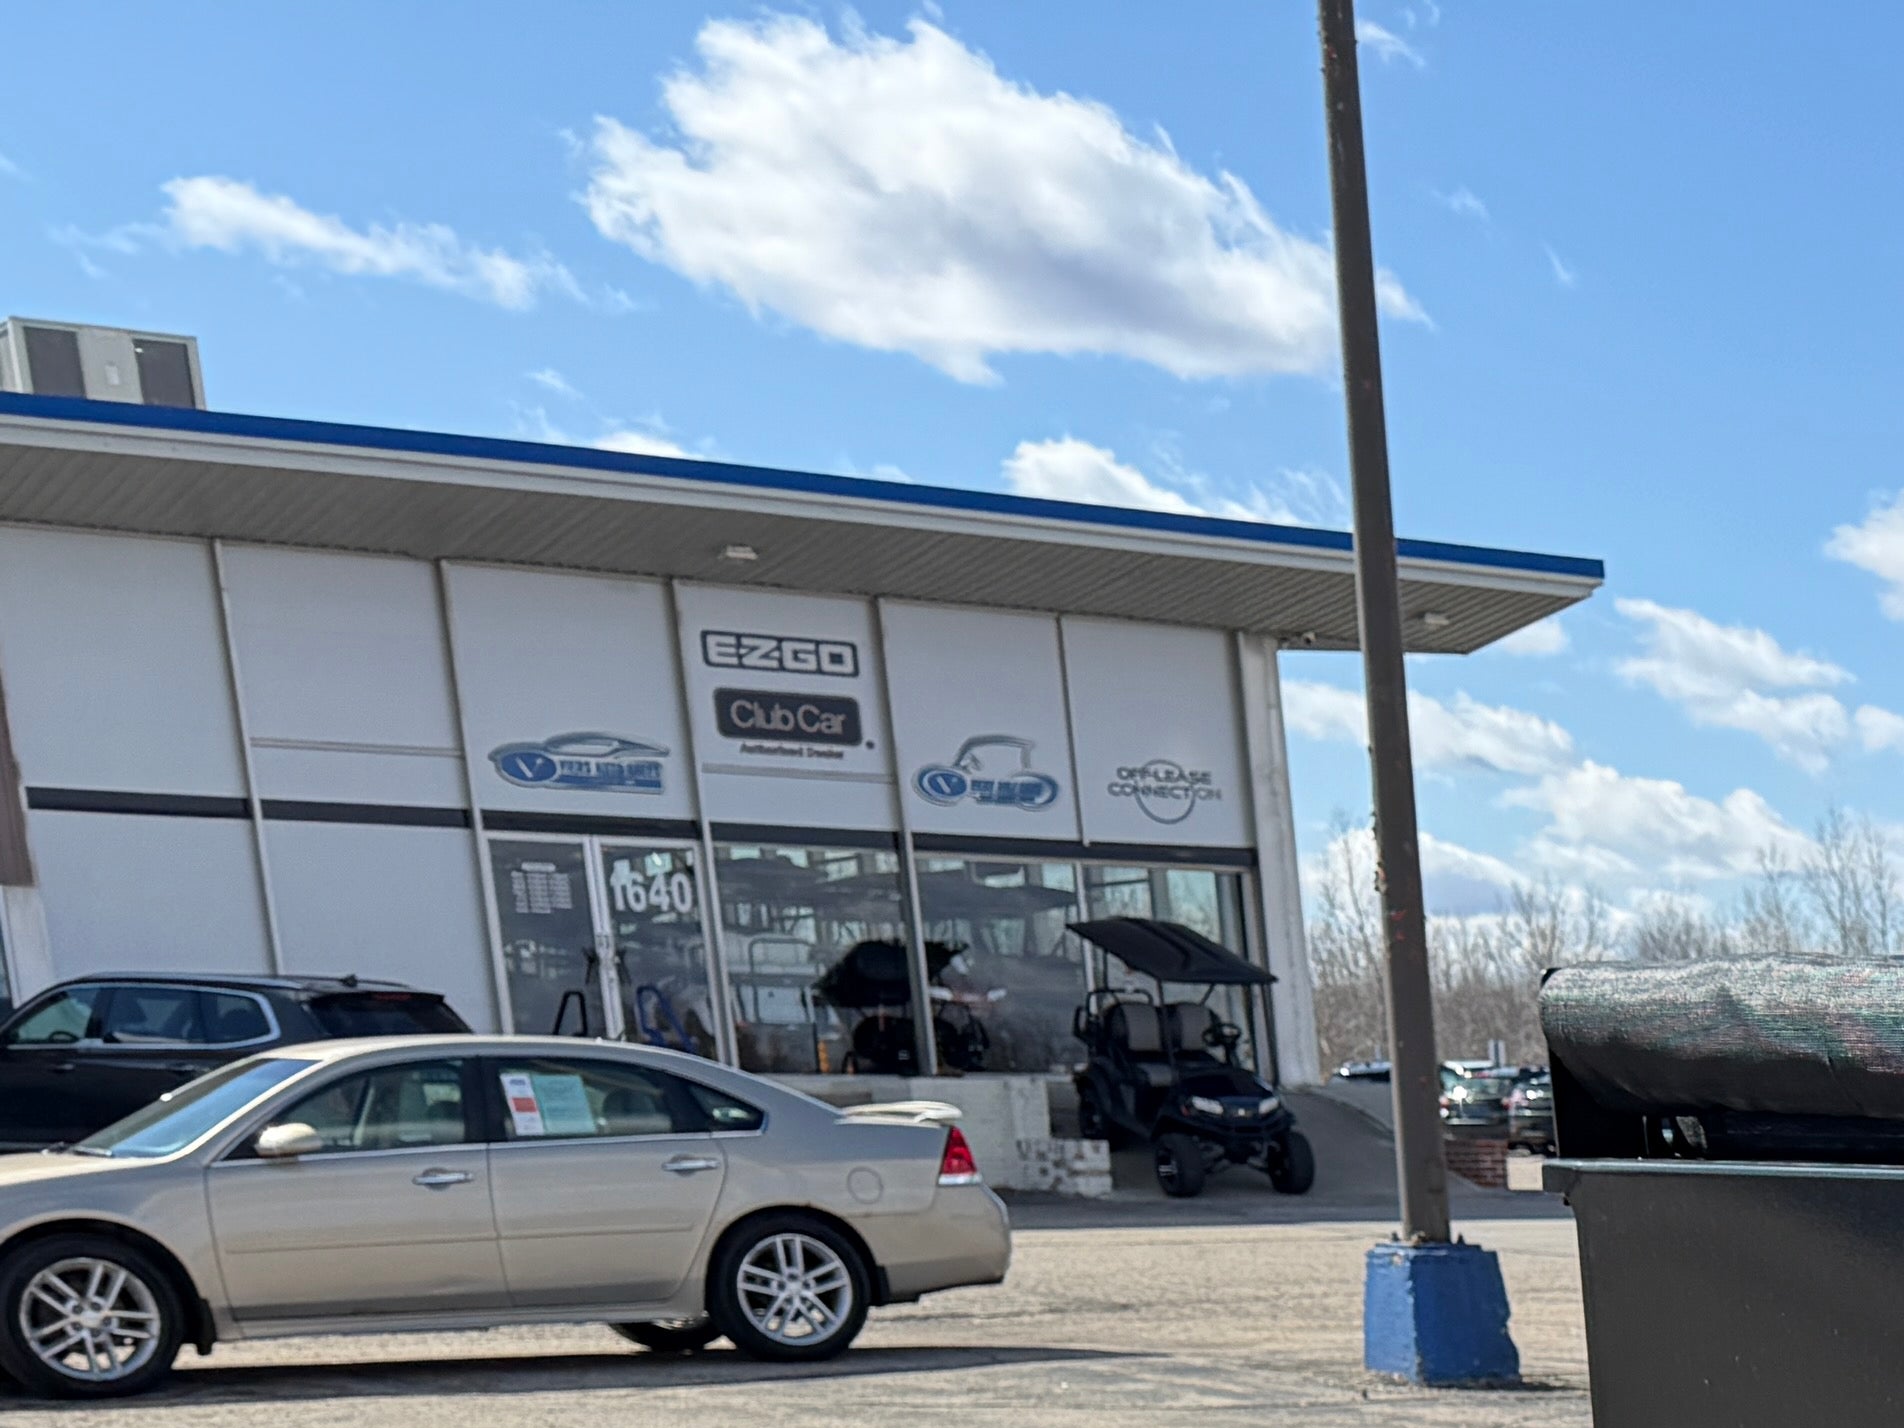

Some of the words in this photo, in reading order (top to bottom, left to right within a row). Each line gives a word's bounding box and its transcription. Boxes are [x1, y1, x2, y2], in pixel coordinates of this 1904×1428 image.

[704, 633, 857, 676] EZGO
[730, 699, 795, 732] Club
[798, 704, 847, 736] Car
[611, 871, 694, 913] 1640
